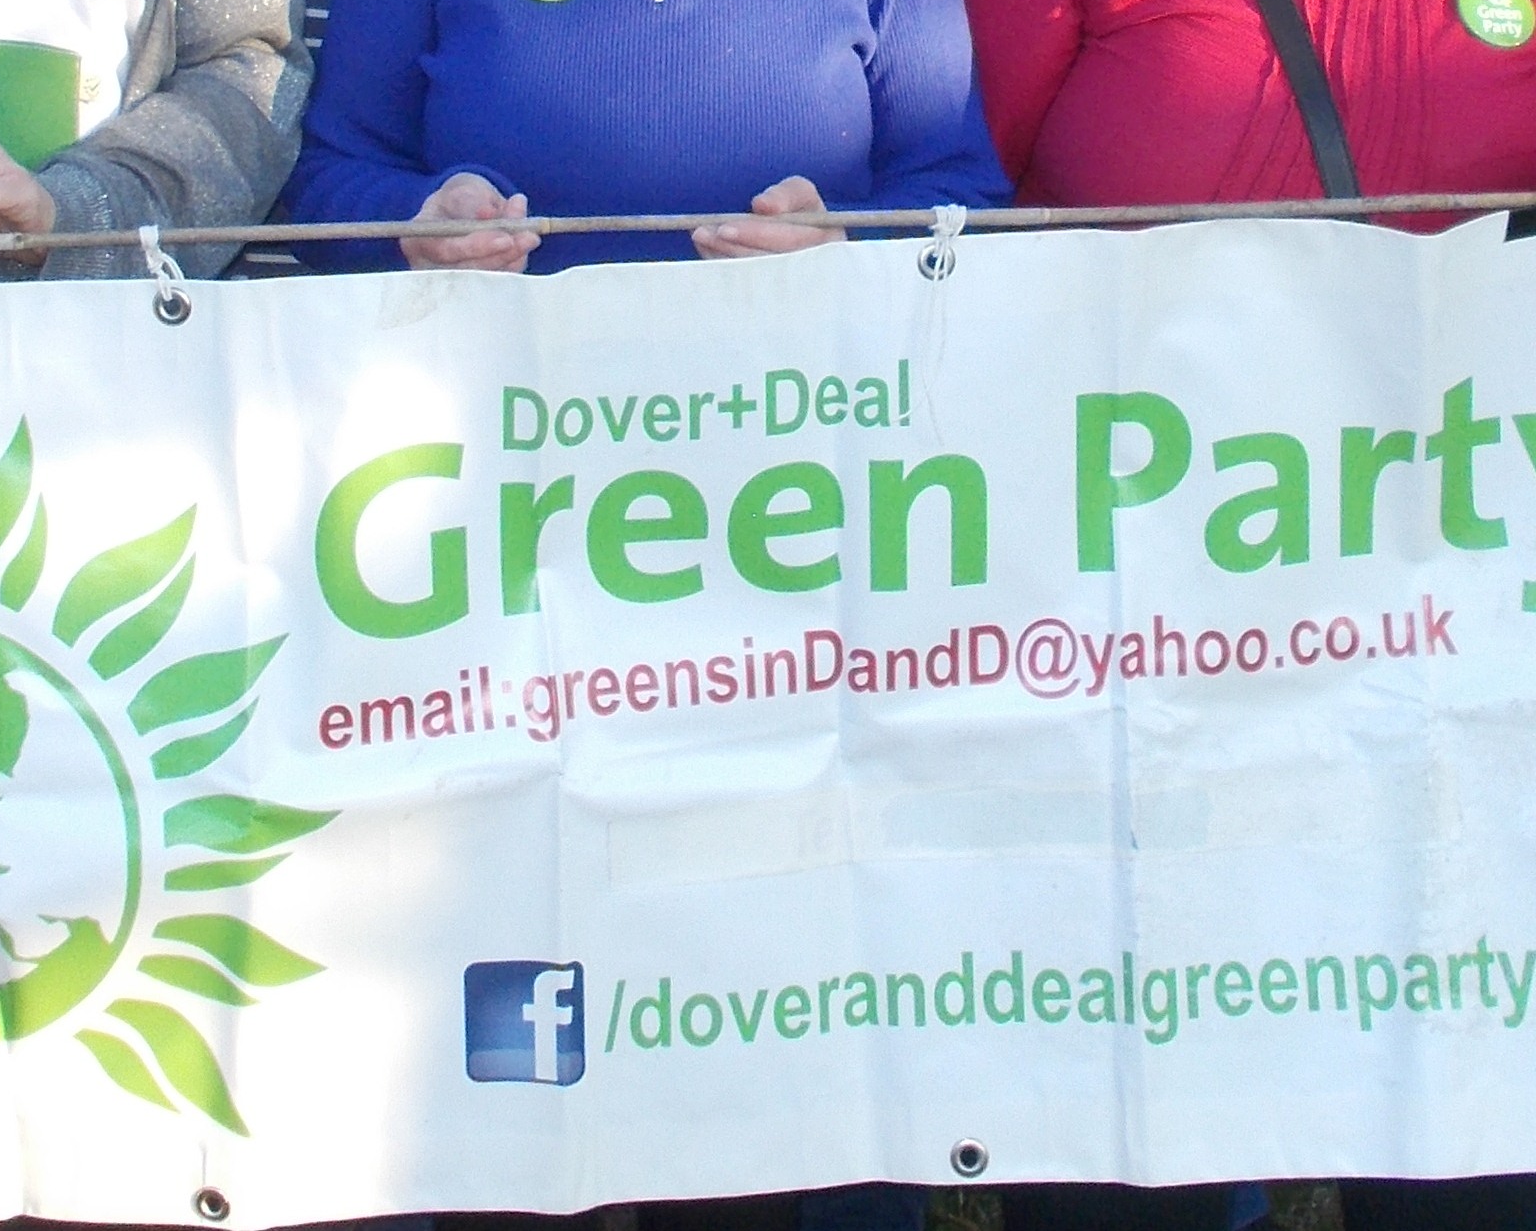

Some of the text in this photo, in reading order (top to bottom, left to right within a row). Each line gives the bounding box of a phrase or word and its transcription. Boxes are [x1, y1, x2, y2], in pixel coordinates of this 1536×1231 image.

[1477, 4, 1523, 21] Green
[1483, 19, 1523, 38] Party
[502, 358, 912, 453] Dover+Deal
[314, 441, 989, 640] Green
